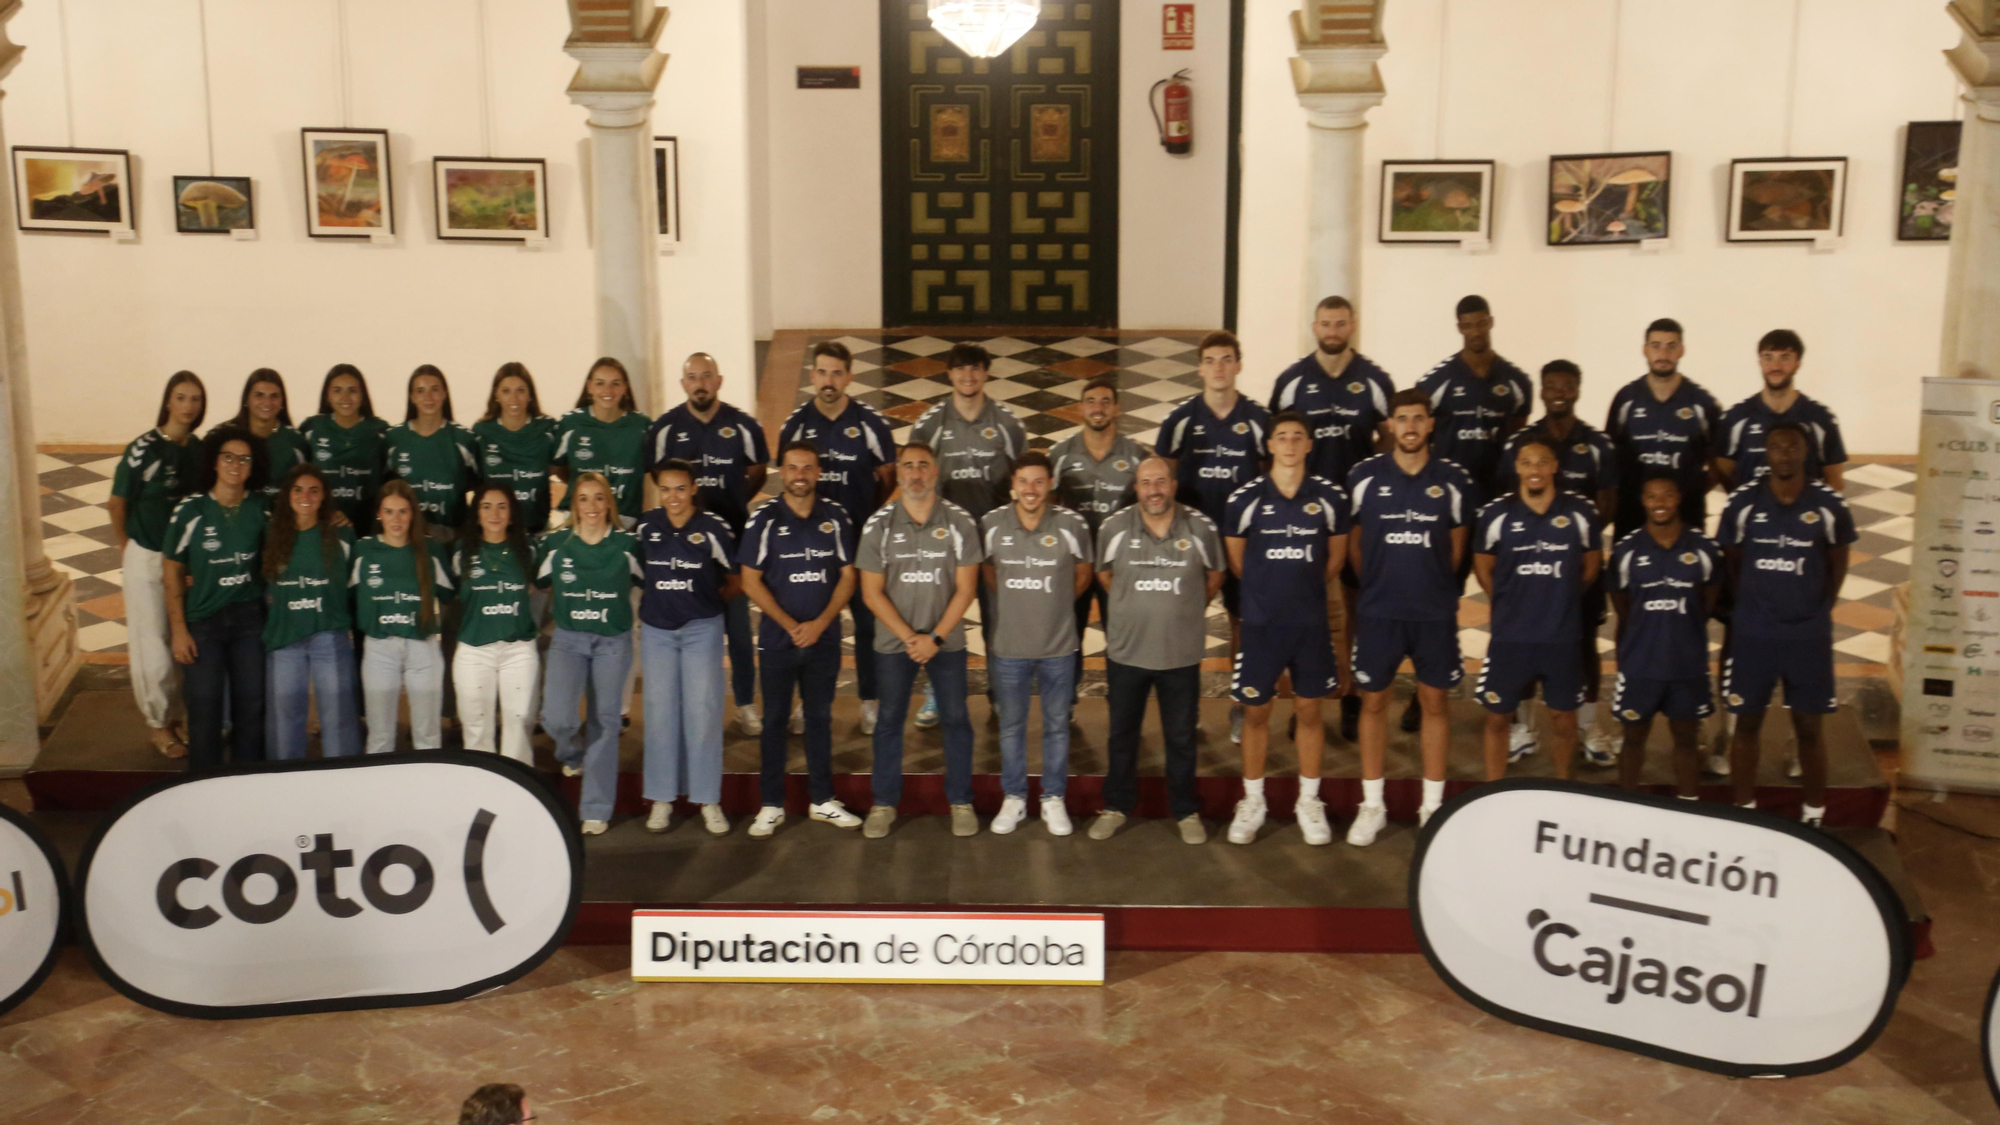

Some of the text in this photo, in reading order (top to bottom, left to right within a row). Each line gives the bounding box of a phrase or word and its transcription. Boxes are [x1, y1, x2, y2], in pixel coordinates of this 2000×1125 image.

[1534, 820, 1778, 898] Fundación
[874, 934, 919, 964] de
[933, 933, 1085, 965] Córdoba
[1527, 909, 1767, 1019] Cajasol
